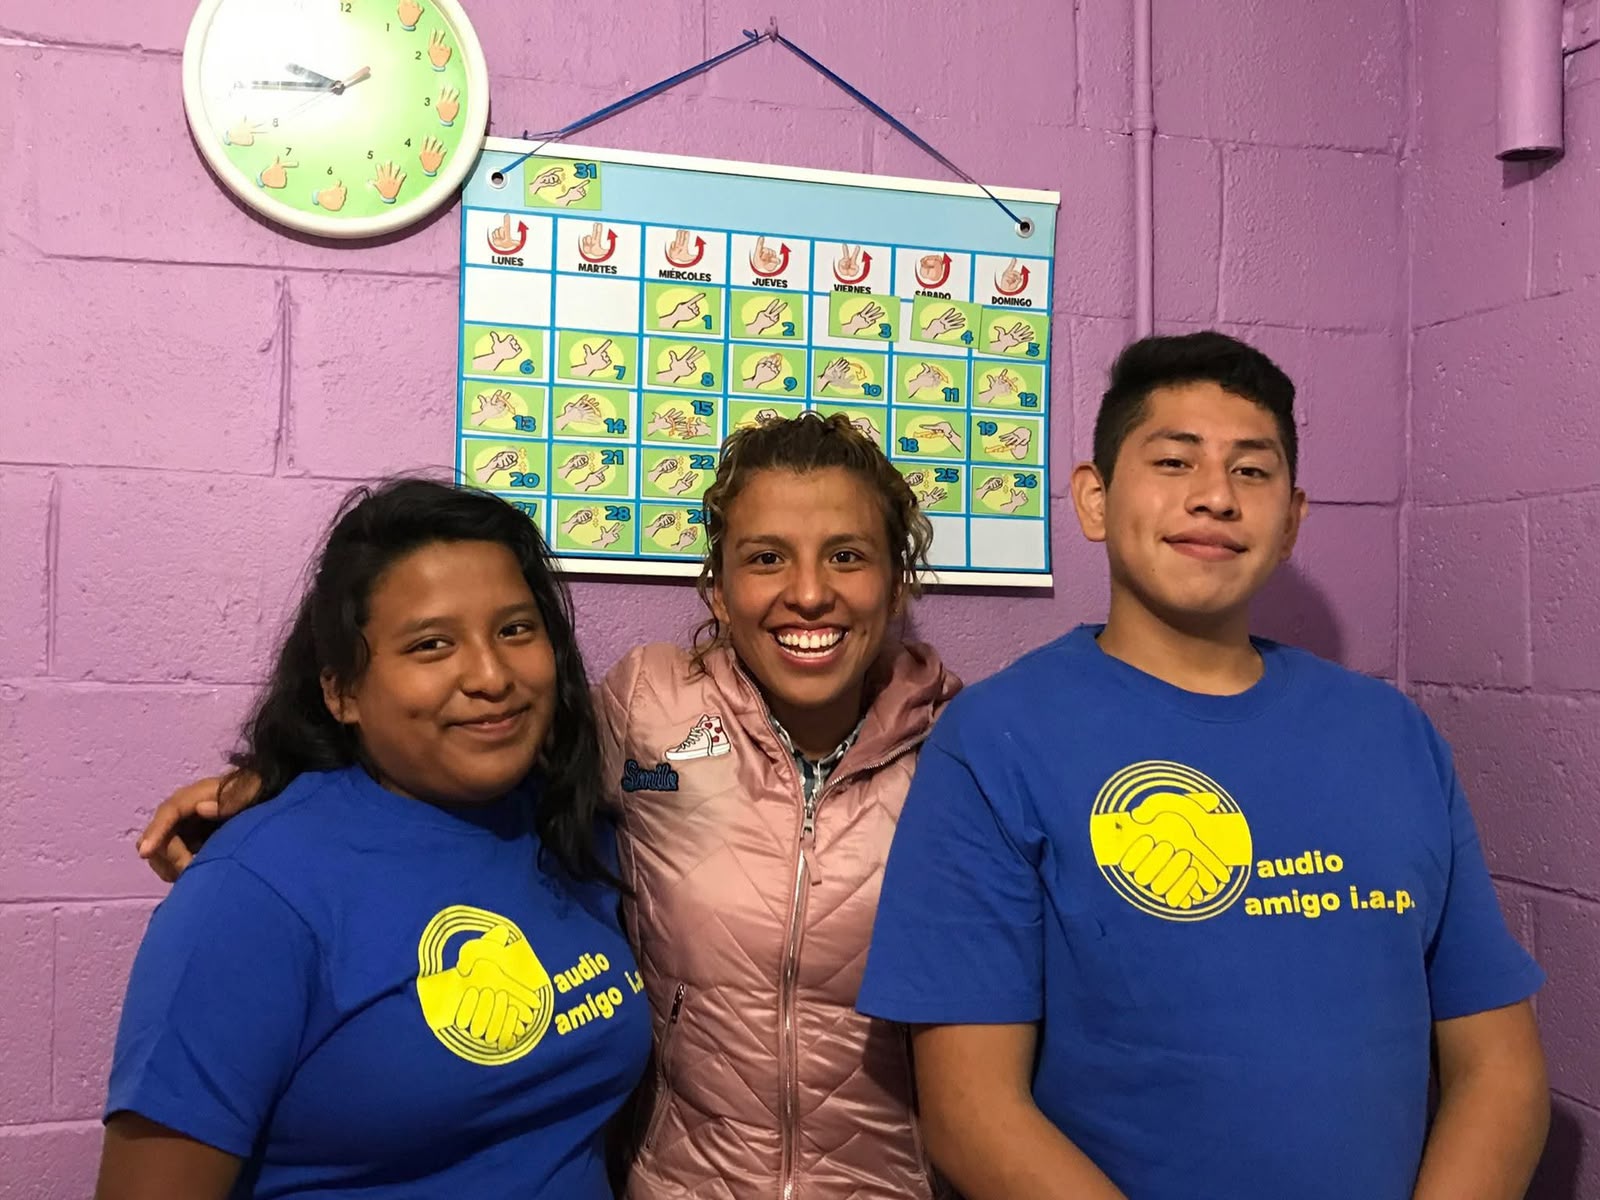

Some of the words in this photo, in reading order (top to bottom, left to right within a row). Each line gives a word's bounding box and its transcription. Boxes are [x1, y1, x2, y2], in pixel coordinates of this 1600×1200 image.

[340, 2, 352, 13] 12
[415, 51, 422, 60] 2
[424, 97, 431, 106] 3
[272, 117, 279, 127] 8
[285, 147, 292, 156] 7
[404, 138, 412, 147] 4
[367, 151, 374, 160] 5
[326, 166, 333, 175] 6
[573, 162, 598, 180] 31
[491, 255, 524, 267] LUNES
[578, 262, 617, 275] MARTES
[658, 267, 712, 282] MIÉRCOLES
[752, 277, 788, 288] JUEVES
[833, 283, 872, 295] VIERNES
[991, 295, 1032, 308] DOMINGO
[701, 315, 713, 330] 1
[781, 322, 796, 337] 2
[878, 323, 892, 339] 3
[960, 330, 974, 345] 4
[1025, 342, 1040, 358] 5
[519, 359, 535, 375] 6
[613, 365, 626, 381] 7
[700, 372, 715, 387] 8
[783, 376, 798, 392] 9
[861, 383, 882, 398] 10
[942, 387, 960, 403] 11
[1017, 391, 1038, 408] 12
[512, 414, 537, 432] 13
[603, 417, 627, 434] 14
[691, 399, 714, 417] 15
[898, 437, 920, 453] 18
[977, 420, 998, 437] 19
[509, 472, 541, 489] 20
[600, 449, 625, 466] 21
[689, 454, 715, 471] 22
[934, 467, 960, 484] 25
[1013, 473, 1038, 489] 26
[604, 505, 631, 522] 28
[1256, 850, 1344, 879] audio
[1244, 889, 1341, 919] amigo
[1349, 885, 1416, 915] i.a.p.
[553, 952, 610, 994] audio
[554, 986, 623, 1035] amigo
